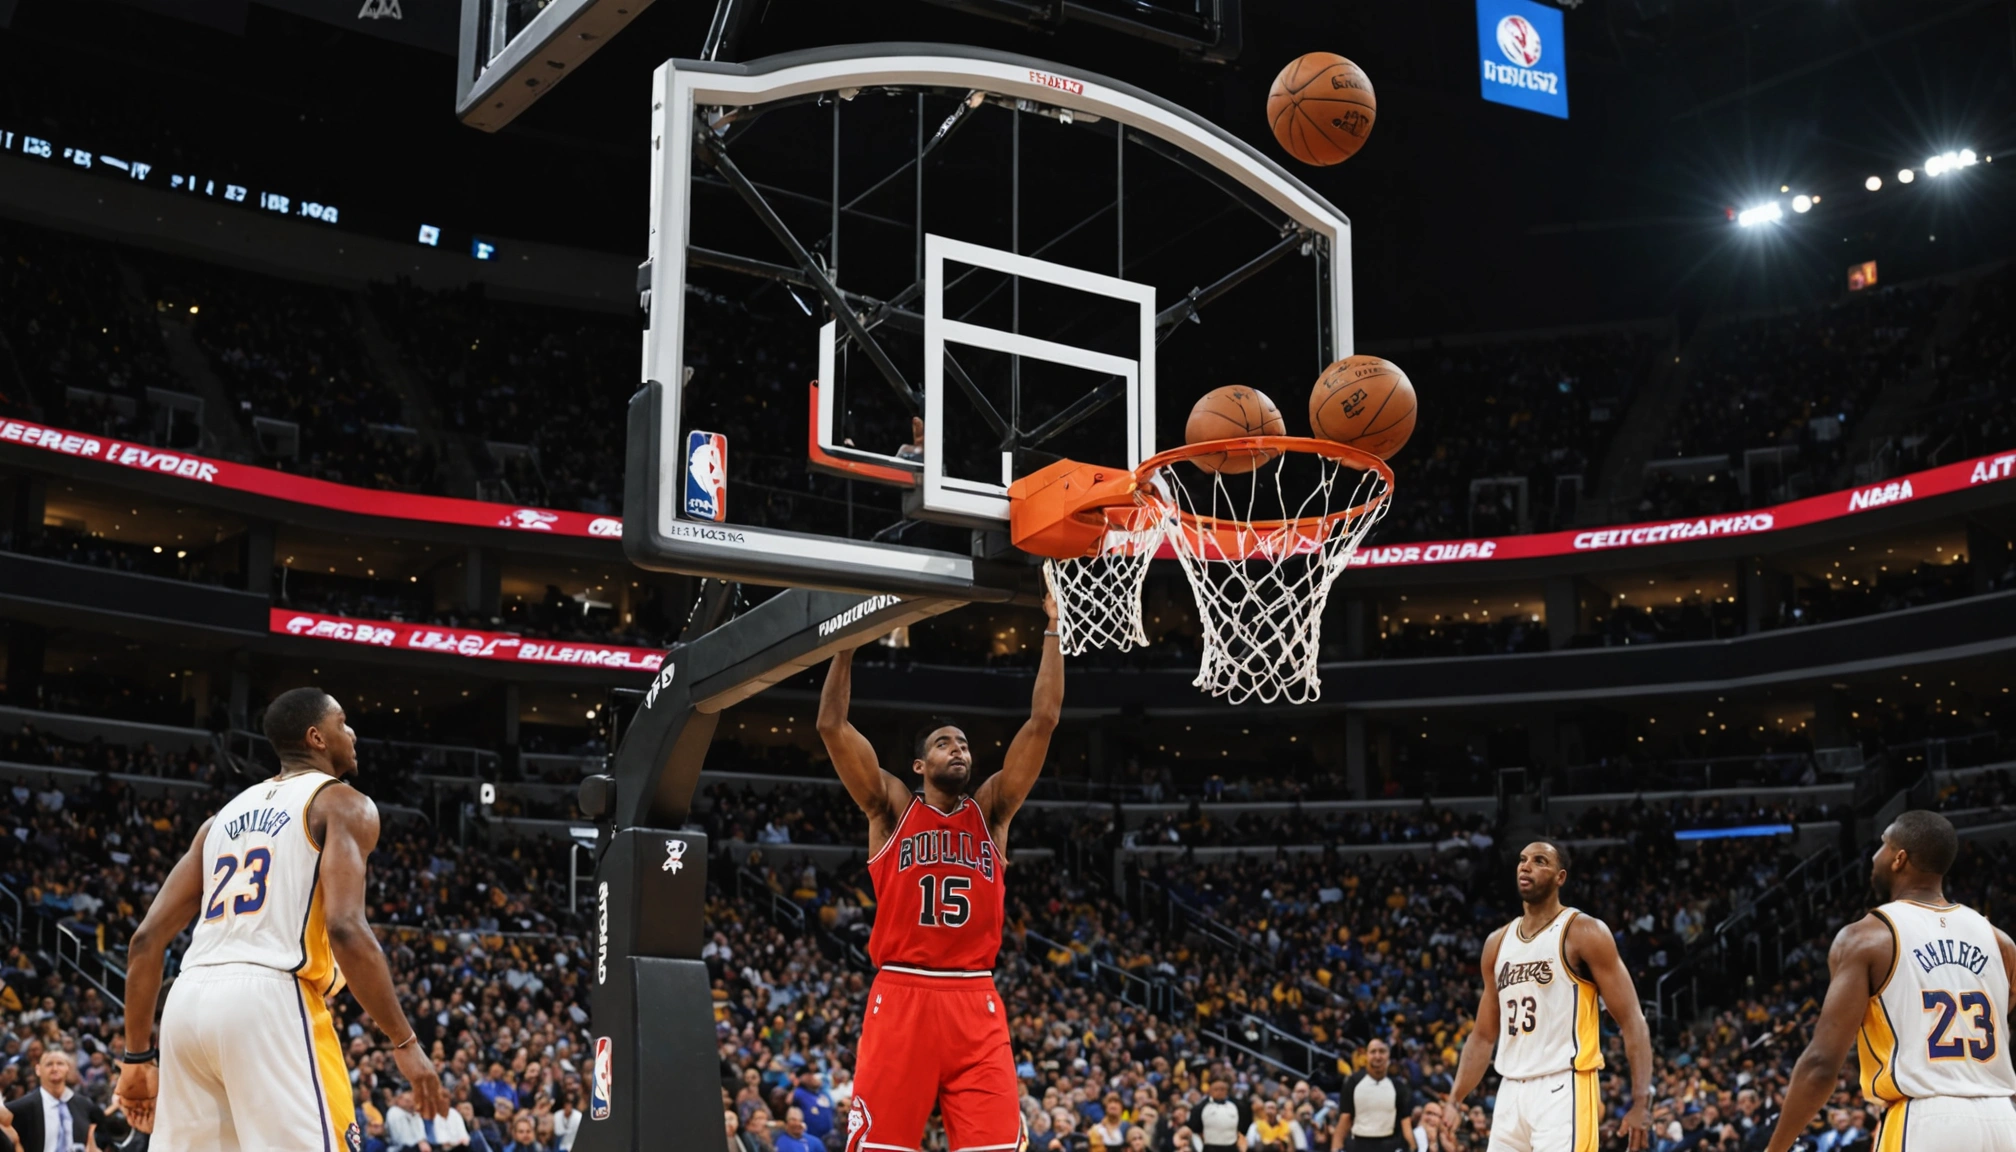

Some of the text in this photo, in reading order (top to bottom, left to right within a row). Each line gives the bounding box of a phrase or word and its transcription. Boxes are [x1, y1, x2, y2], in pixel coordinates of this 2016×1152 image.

[204, 846, 272, 924] 23
[918, 873, 971, 928] 15
[1922, 989, 1997, 1063] 23
